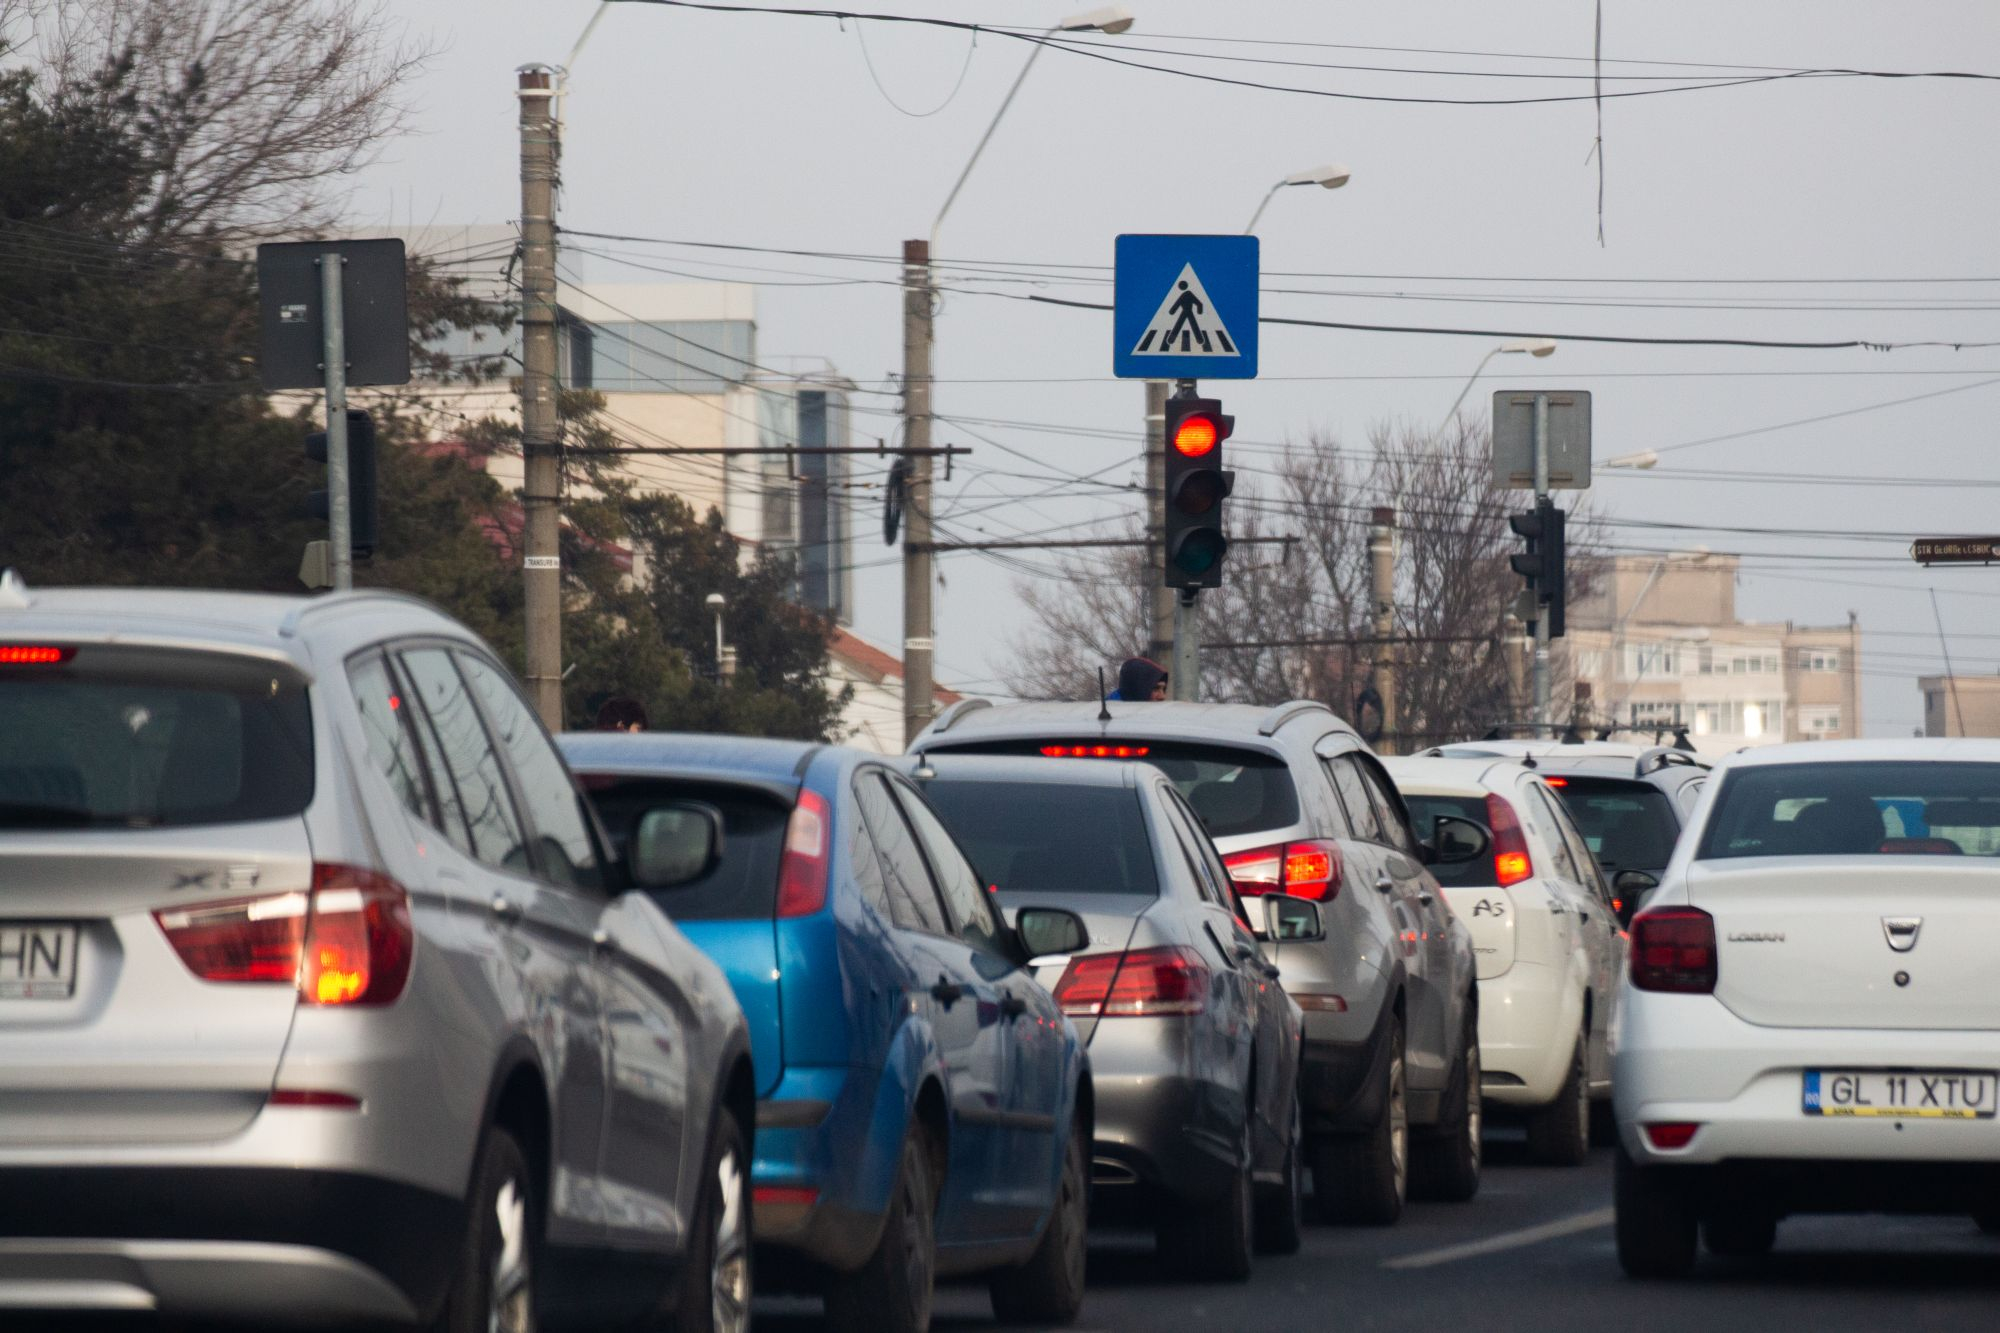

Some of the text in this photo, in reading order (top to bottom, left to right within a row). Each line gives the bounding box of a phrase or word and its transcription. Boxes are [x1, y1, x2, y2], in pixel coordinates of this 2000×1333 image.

[1832, 1076, 1984, 1106] GL 11 XTU
